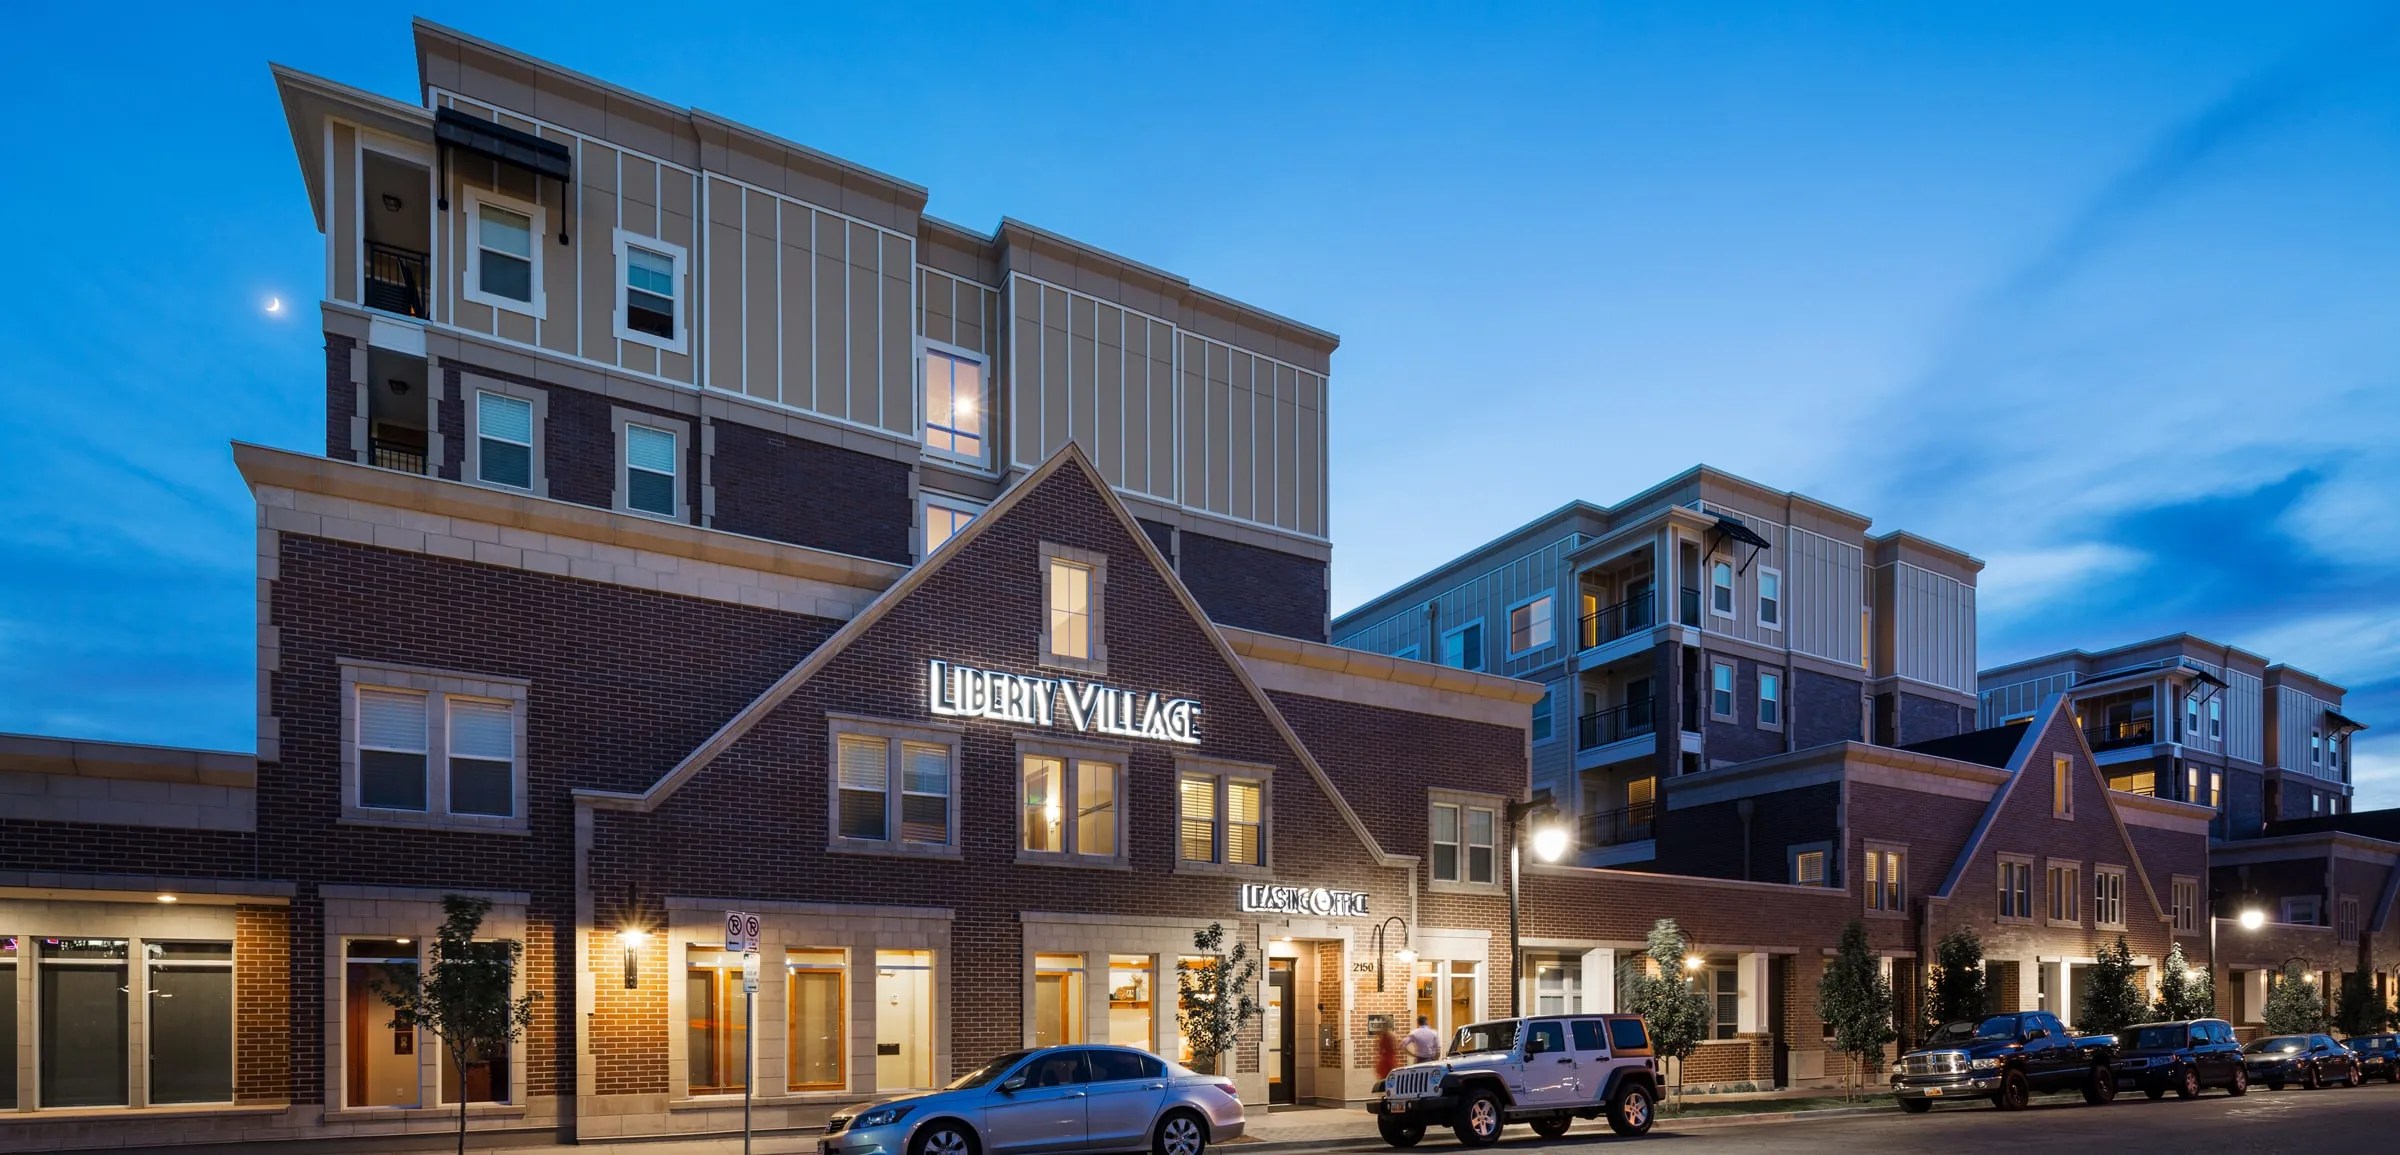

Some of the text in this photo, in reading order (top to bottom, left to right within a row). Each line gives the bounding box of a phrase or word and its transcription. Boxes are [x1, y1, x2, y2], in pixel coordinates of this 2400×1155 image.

[930, 659, 1201, 744] LIBERTY VILLAGE
[1240, 883, 1369, 917] LEASING OFFICE
[1353, 962, 1374, 972] 2150
